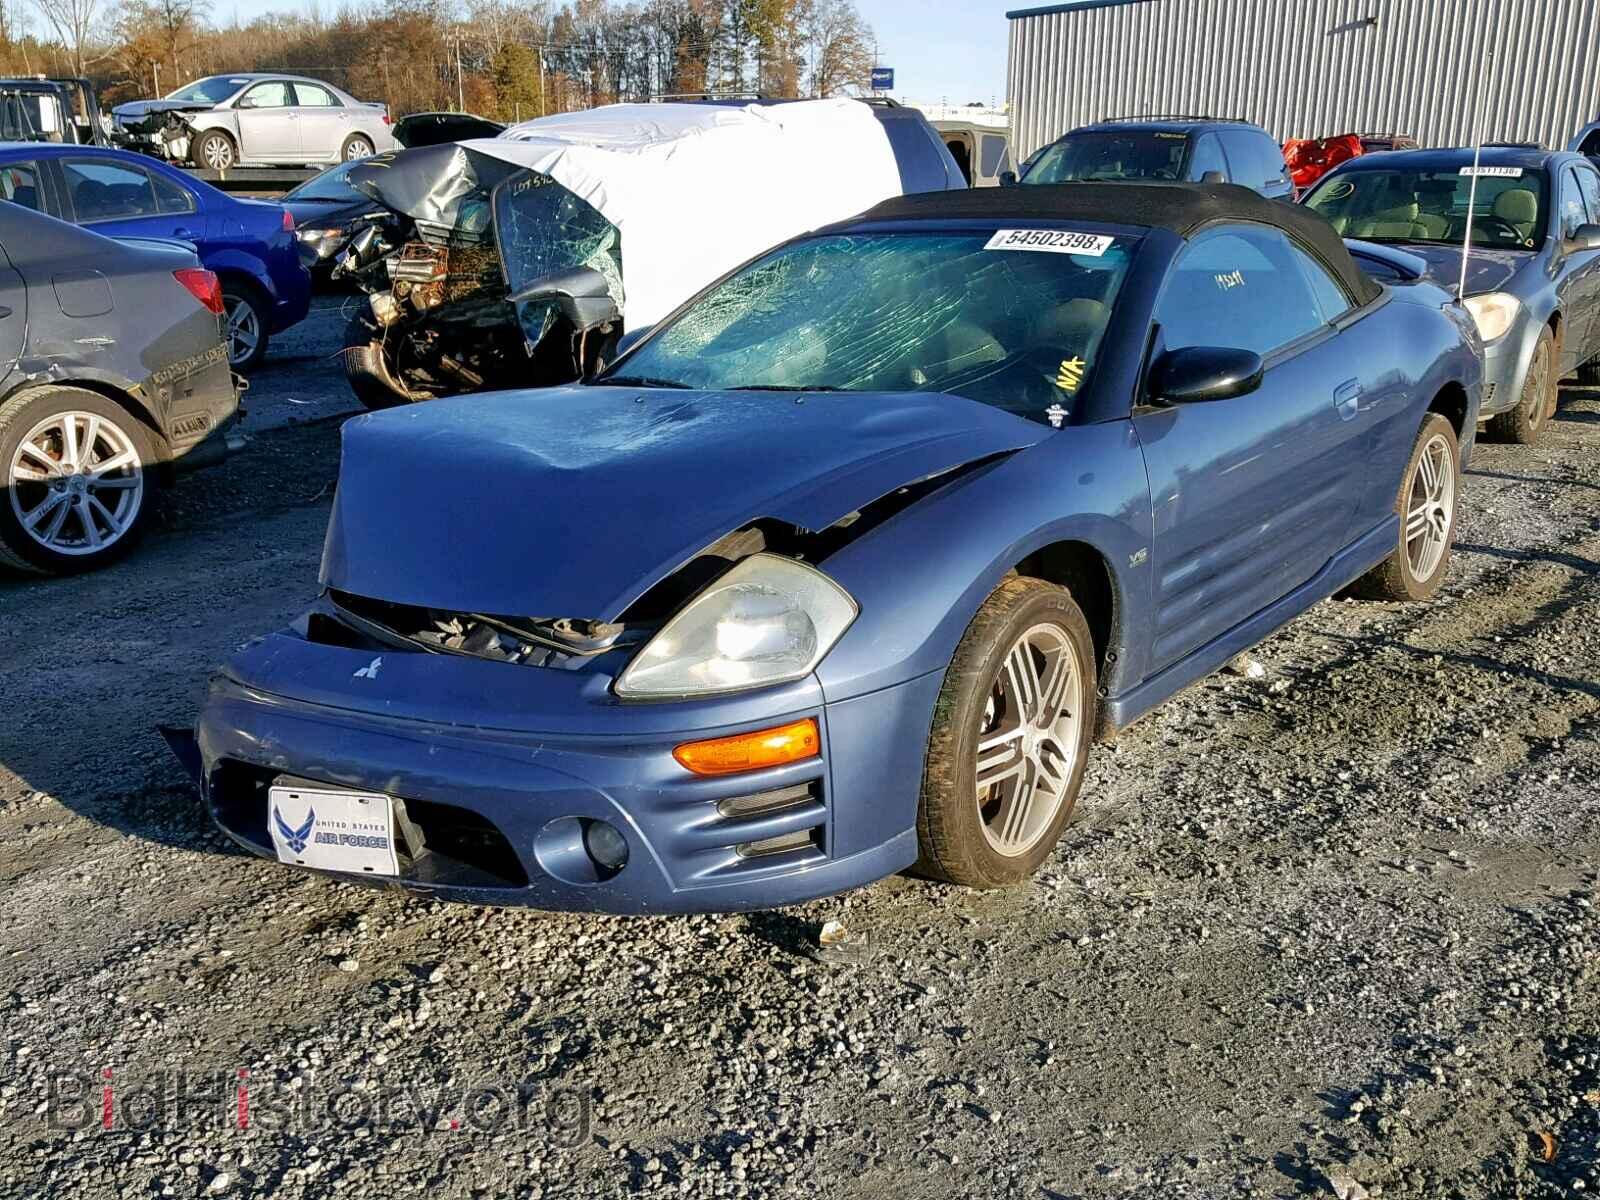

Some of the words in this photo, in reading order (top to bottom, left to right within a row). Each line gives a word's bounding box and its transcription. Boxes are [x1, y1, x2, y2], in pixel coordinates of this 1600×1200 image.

[1006, 231, 1098, 249] 54502398
[1056, 355, 1086, 390] N/A
[315, 820, 347, 829] UNITED
[352, 822, 386, 831] STATES
[314, 832, 339, 845] AIR
[339, 834, 388, 849] FORCE
